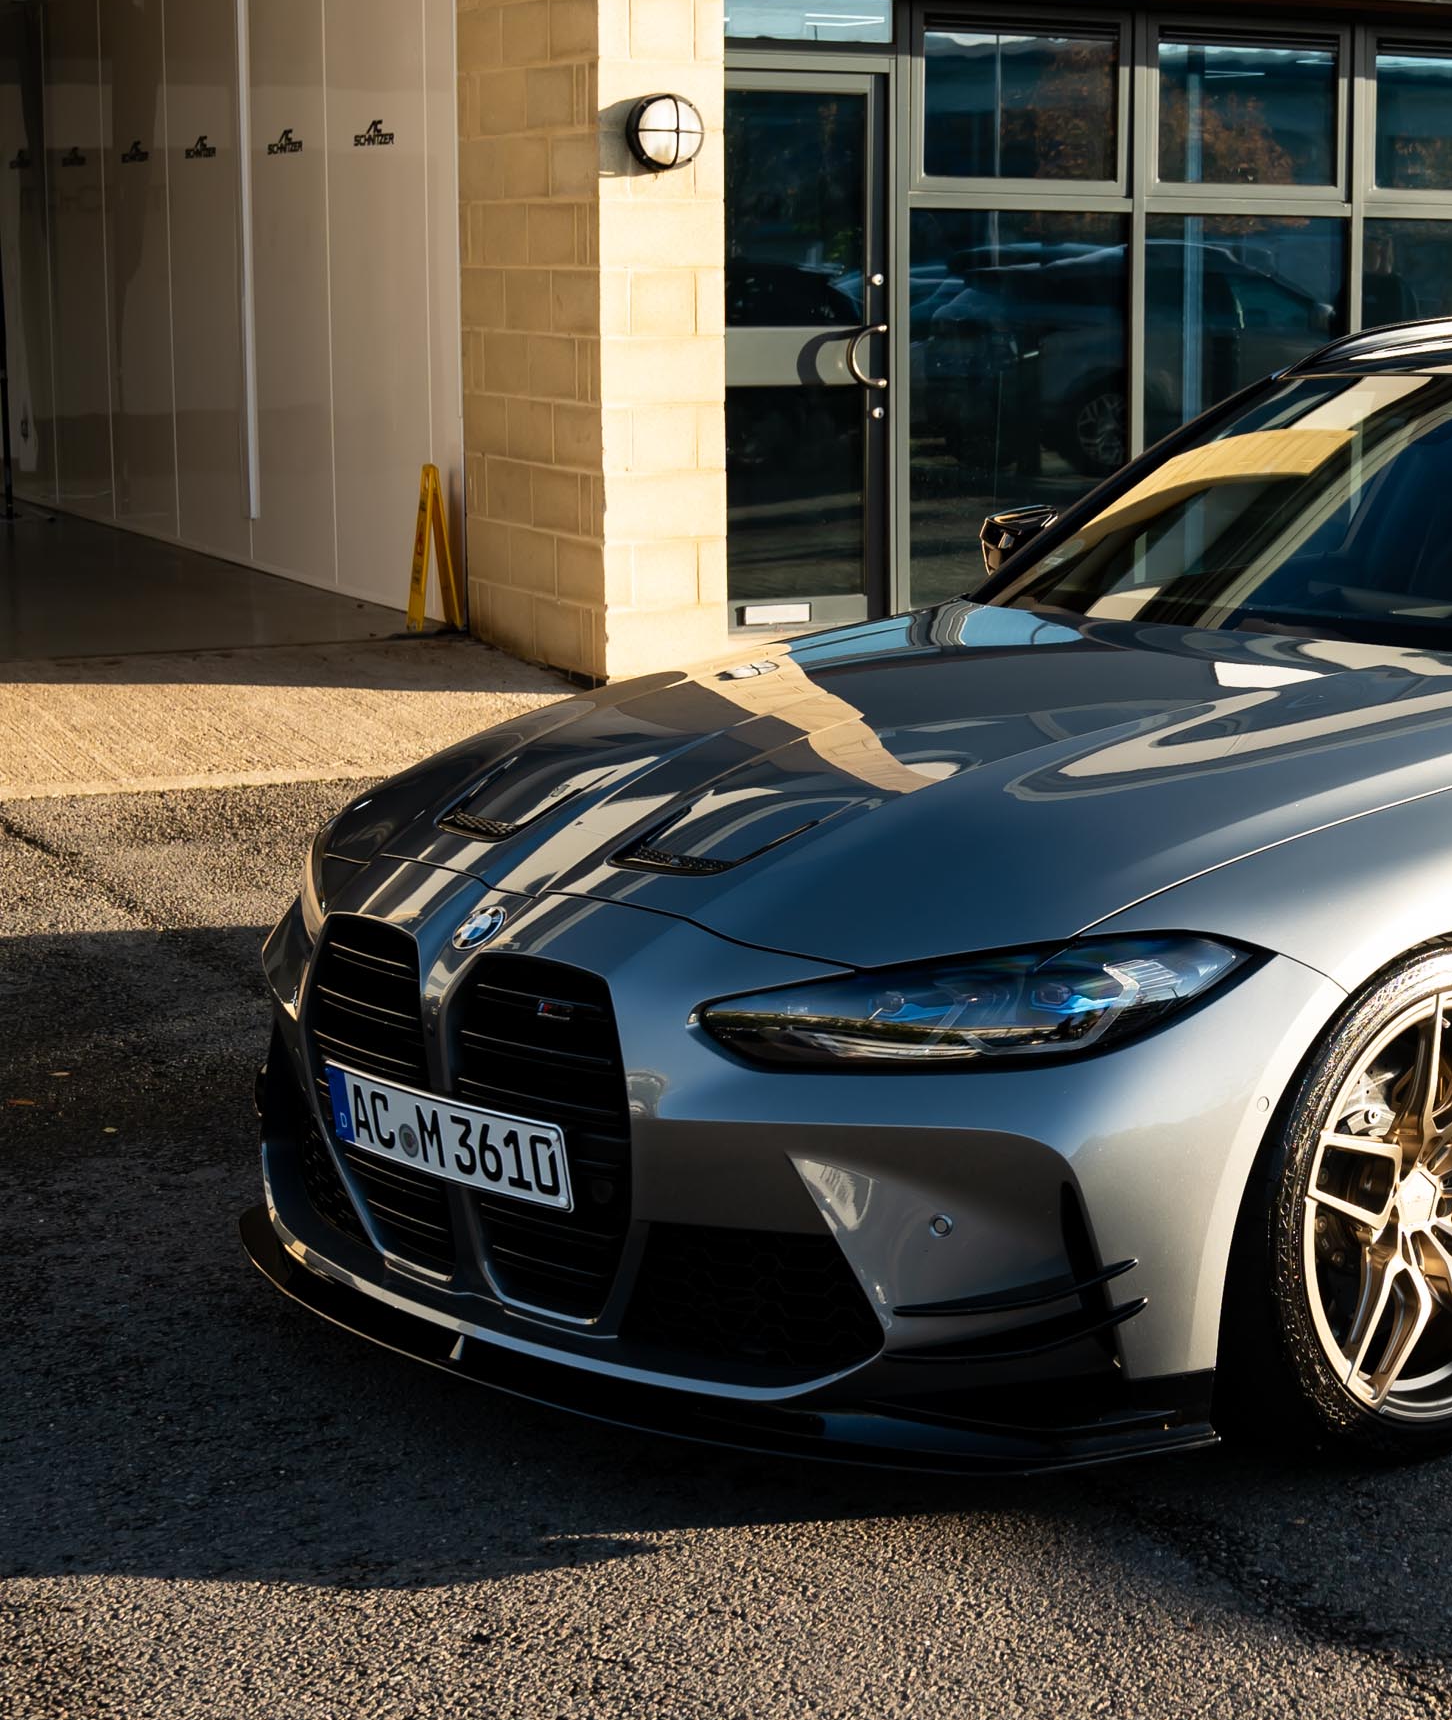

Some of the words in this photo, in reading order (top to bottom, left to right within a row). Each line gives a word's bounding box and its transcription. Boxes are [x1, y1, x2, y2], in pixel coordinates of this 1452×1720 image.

[353, 133, 394, 146] SCHNITZER
[340, 1111, 348, 1128] D
[352, 1083, 396, 1150] AC
[414, 1103, 446, 1169] M
[450, 1115, 561, 1196] 3610
